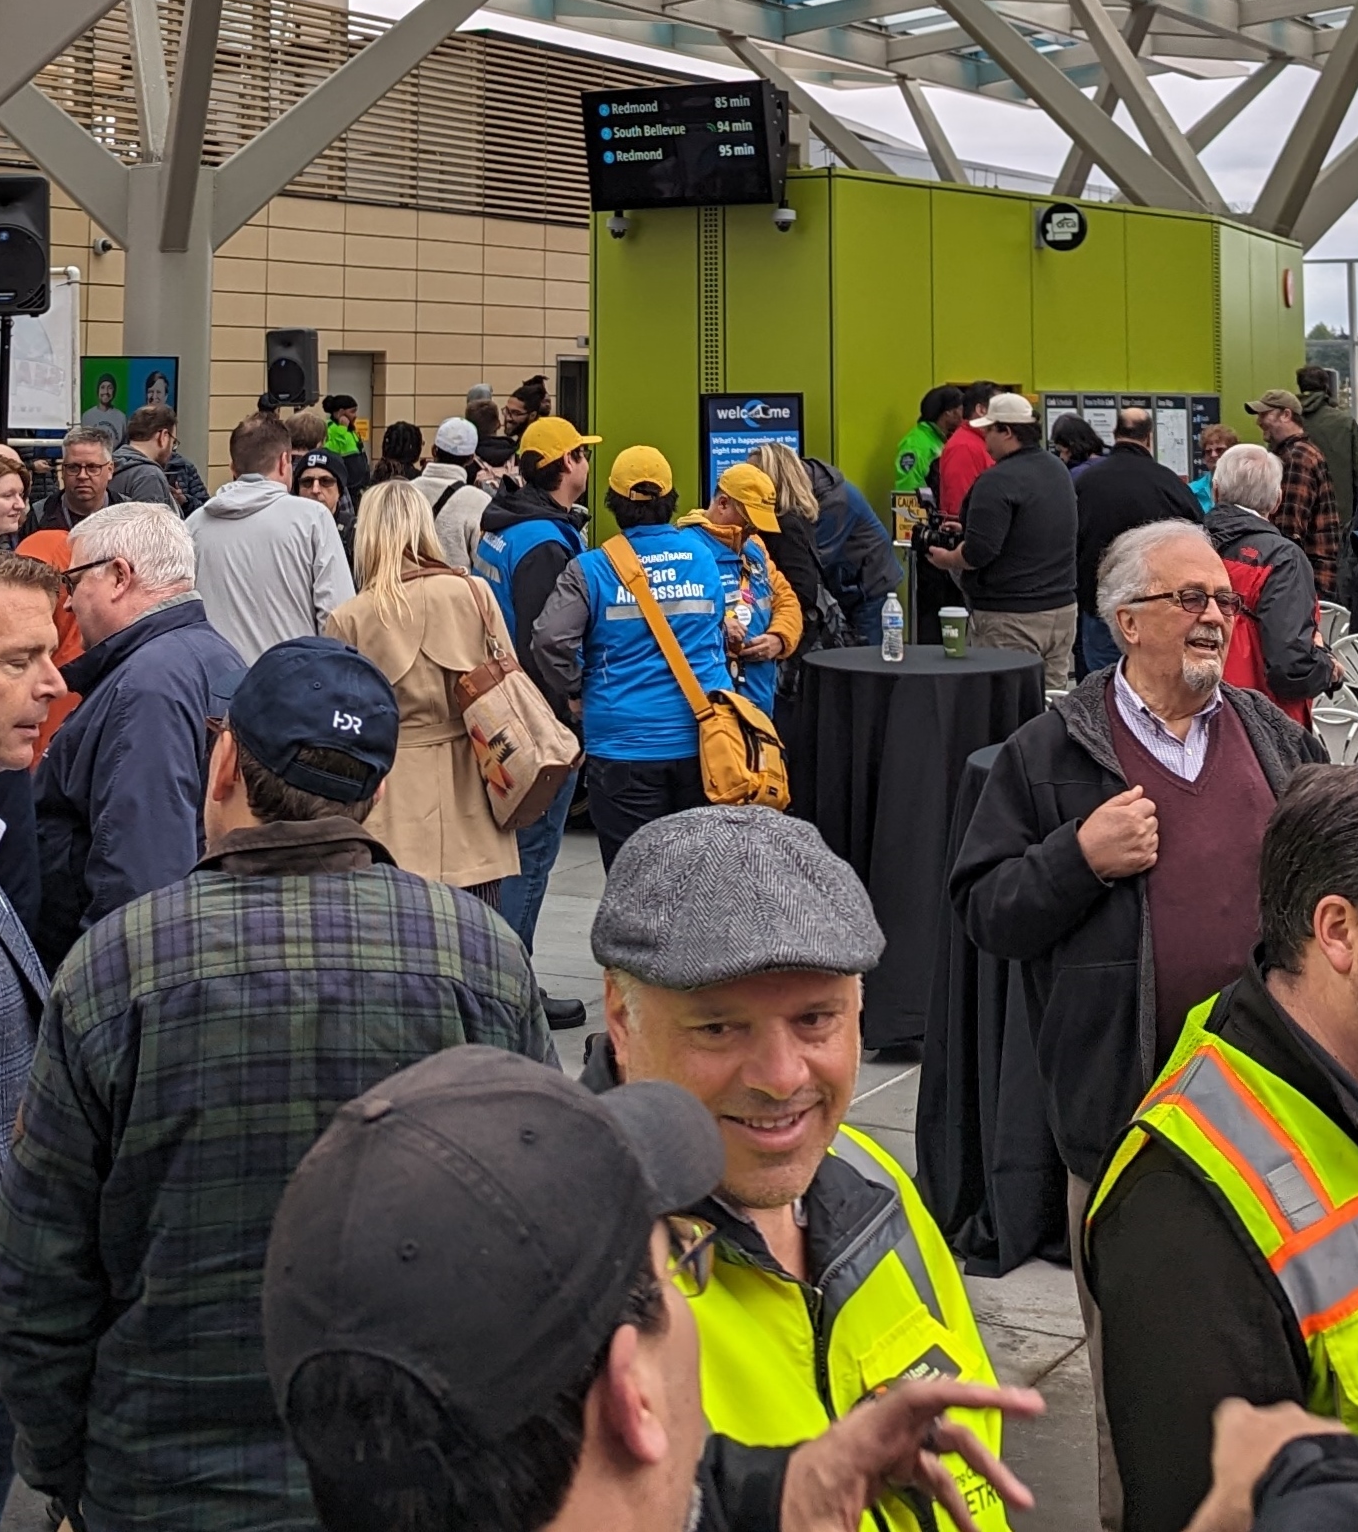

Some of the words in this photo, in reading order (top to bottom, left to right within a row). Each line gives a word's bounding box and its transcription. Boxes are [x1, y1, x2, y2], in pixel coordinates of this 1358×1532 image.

[611, 100, 659, 115] Redmond
[714, 96, 728, 108] 85
[729, 95, 751, 108] min
[613, 125, 642, 139] South
[643, 123, 686, 138] Bellevue
[717, 120, 731, 133] 94
[731, 119, 753, 132] min
[615, 147, 663, 162] Redmond
[718, 144, 732, 157] 95
[733, 143, 755, 156] min
[712, 436, 736, 445] What's
[332, 709, 363, 735] HDR
